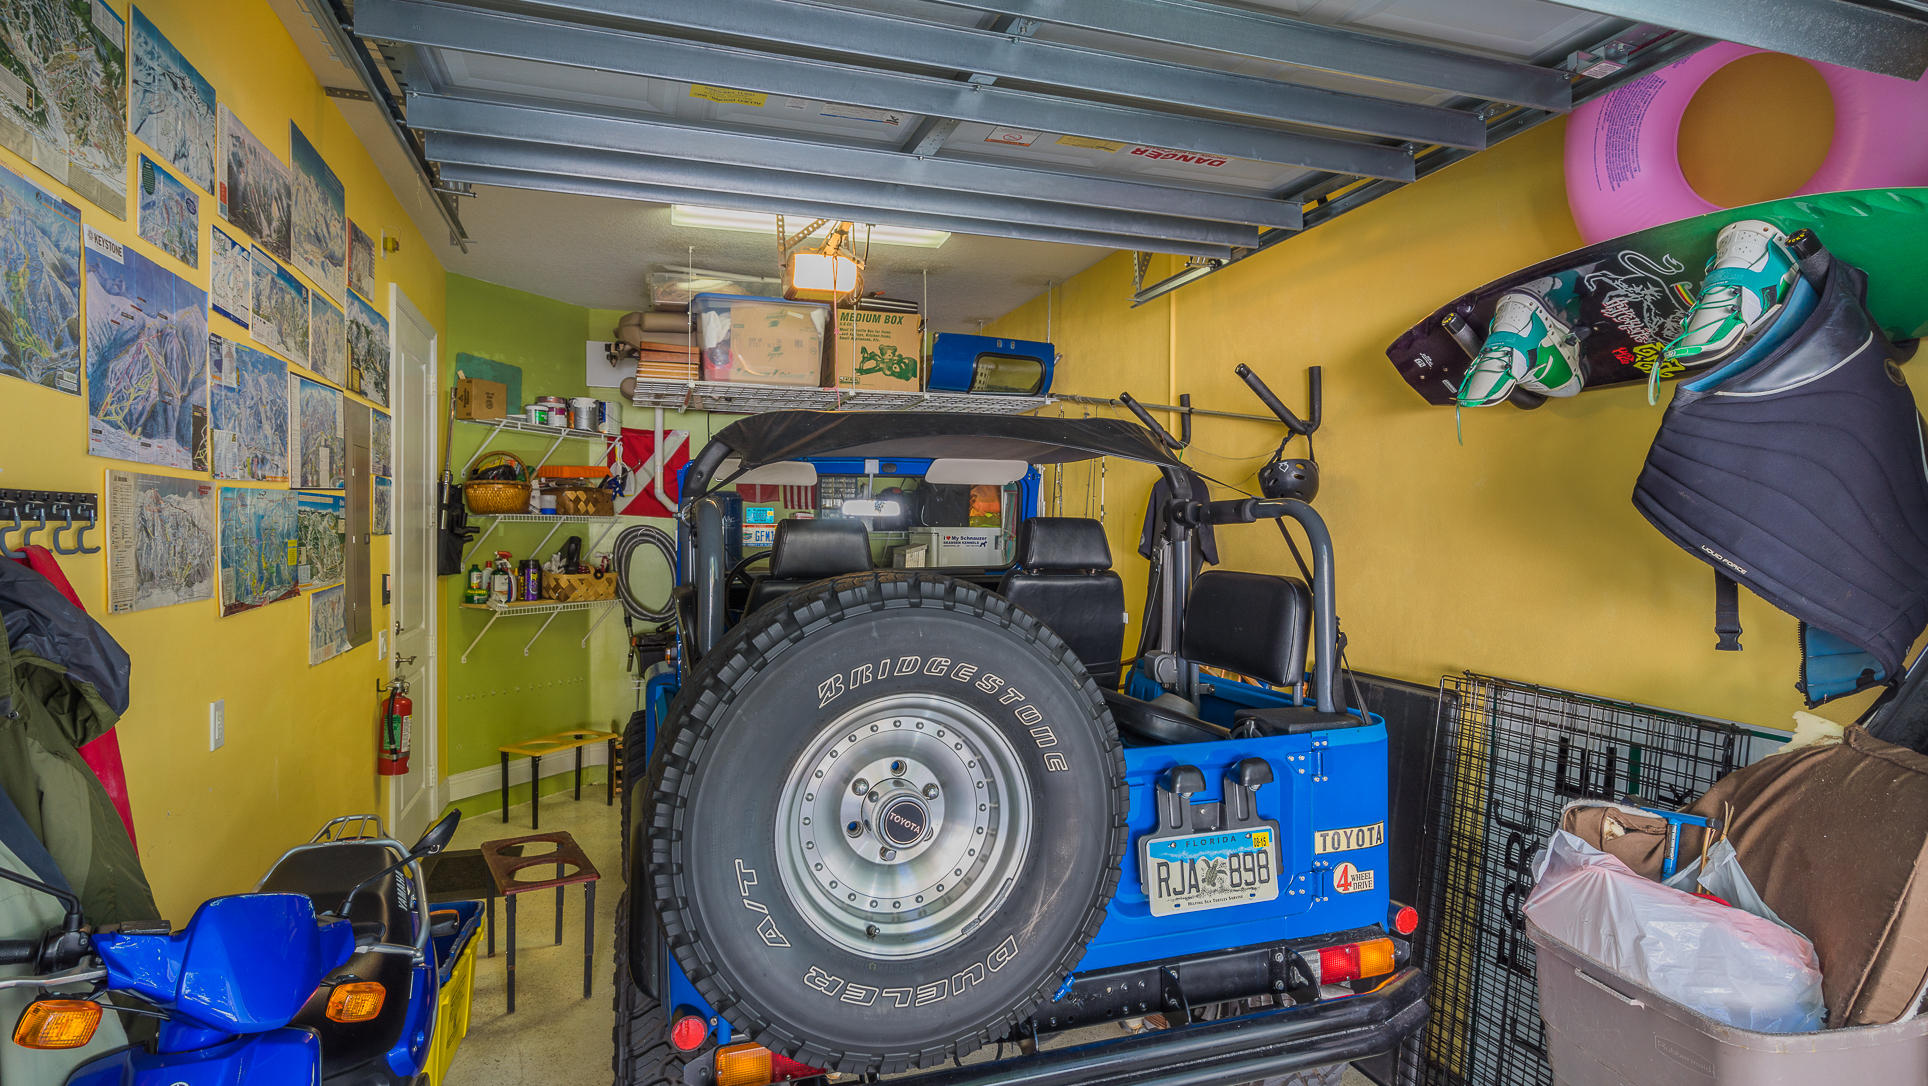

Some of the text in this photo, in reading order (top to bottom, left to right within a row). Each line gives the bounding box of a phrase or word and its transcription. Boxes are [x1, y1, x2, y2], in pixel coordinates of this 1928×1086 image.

[1130, 147, 1226, 167] DANGER
[94, 233, 123, 257] KEYSTONE
[840, 312, 904, 325] MEDIUM BOX
[1701, 544, 1748, 575] LIQUID FORCE
[817, 656, 1068, 772] BRIDGESTONE
[890, 812, 920, 834] TOYOTA
[1185, 835, 1236, 848] FLORIDA
[1320, 825, 1382, 852] TOYOTA
[1157, 849, 1270, 898] RJA 898
[1336, 864, 1373, 892] 4 WHEEL
[1352, 880, 1373, 890] DRIVE
[394, 869, 408, 911] YAMAHA
[734, 858, 791, 948] A/T
[803, 934, 1019, 1008] DUELER
